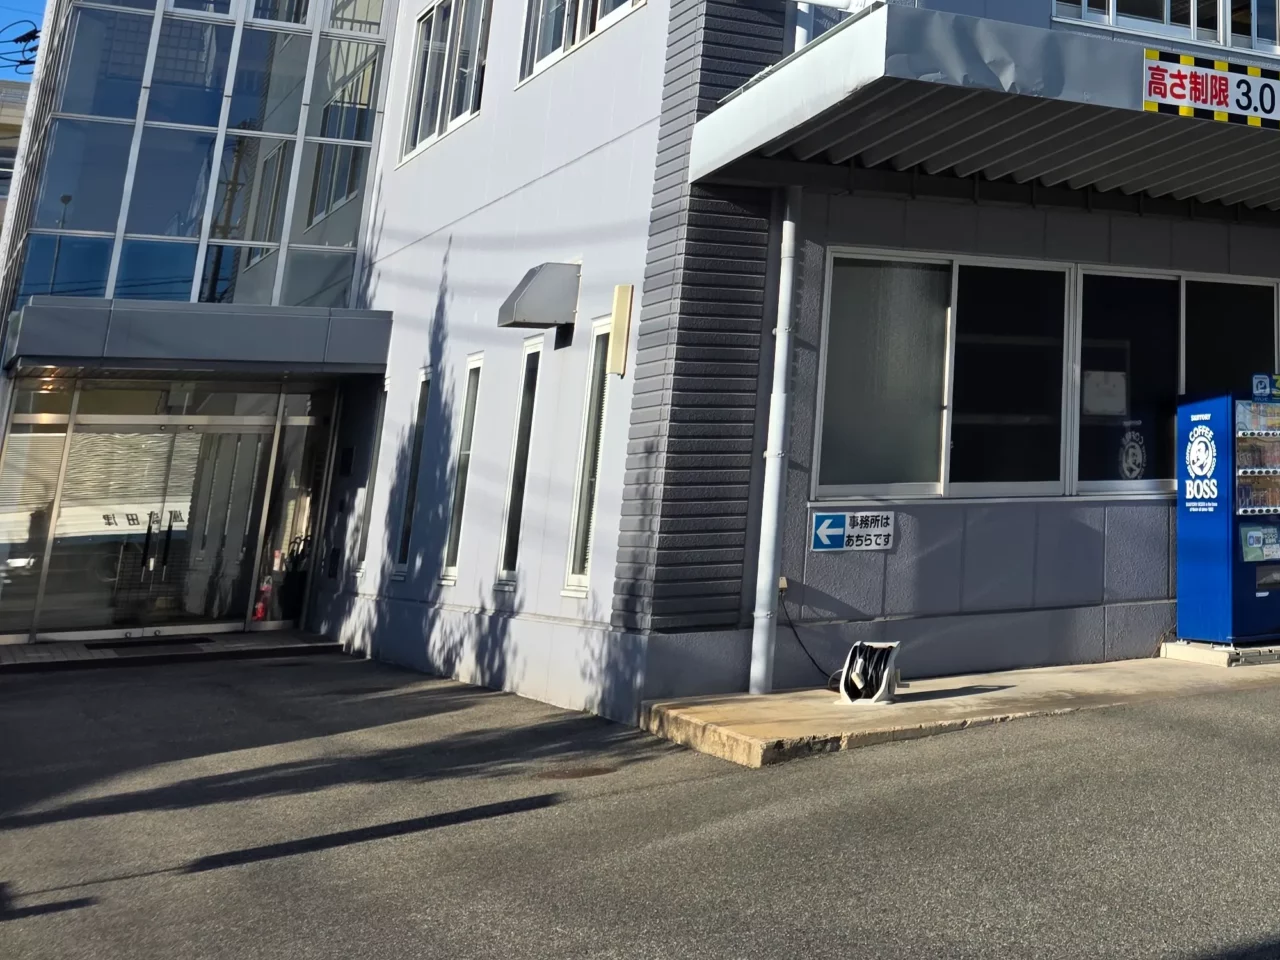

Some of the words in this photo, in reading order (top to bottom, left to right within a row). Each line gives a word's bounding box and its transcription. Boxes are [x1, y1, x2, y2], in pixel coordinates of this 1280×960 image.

[1147, 65, 1229, 108] 高さ制限
[1189, 425, 1214, 441] COFFEE
[1185, 479, 1218, 499] BOSS
[848, 515, 890, 529] 事務所は
[845, 533, 891, 547] あちらです
